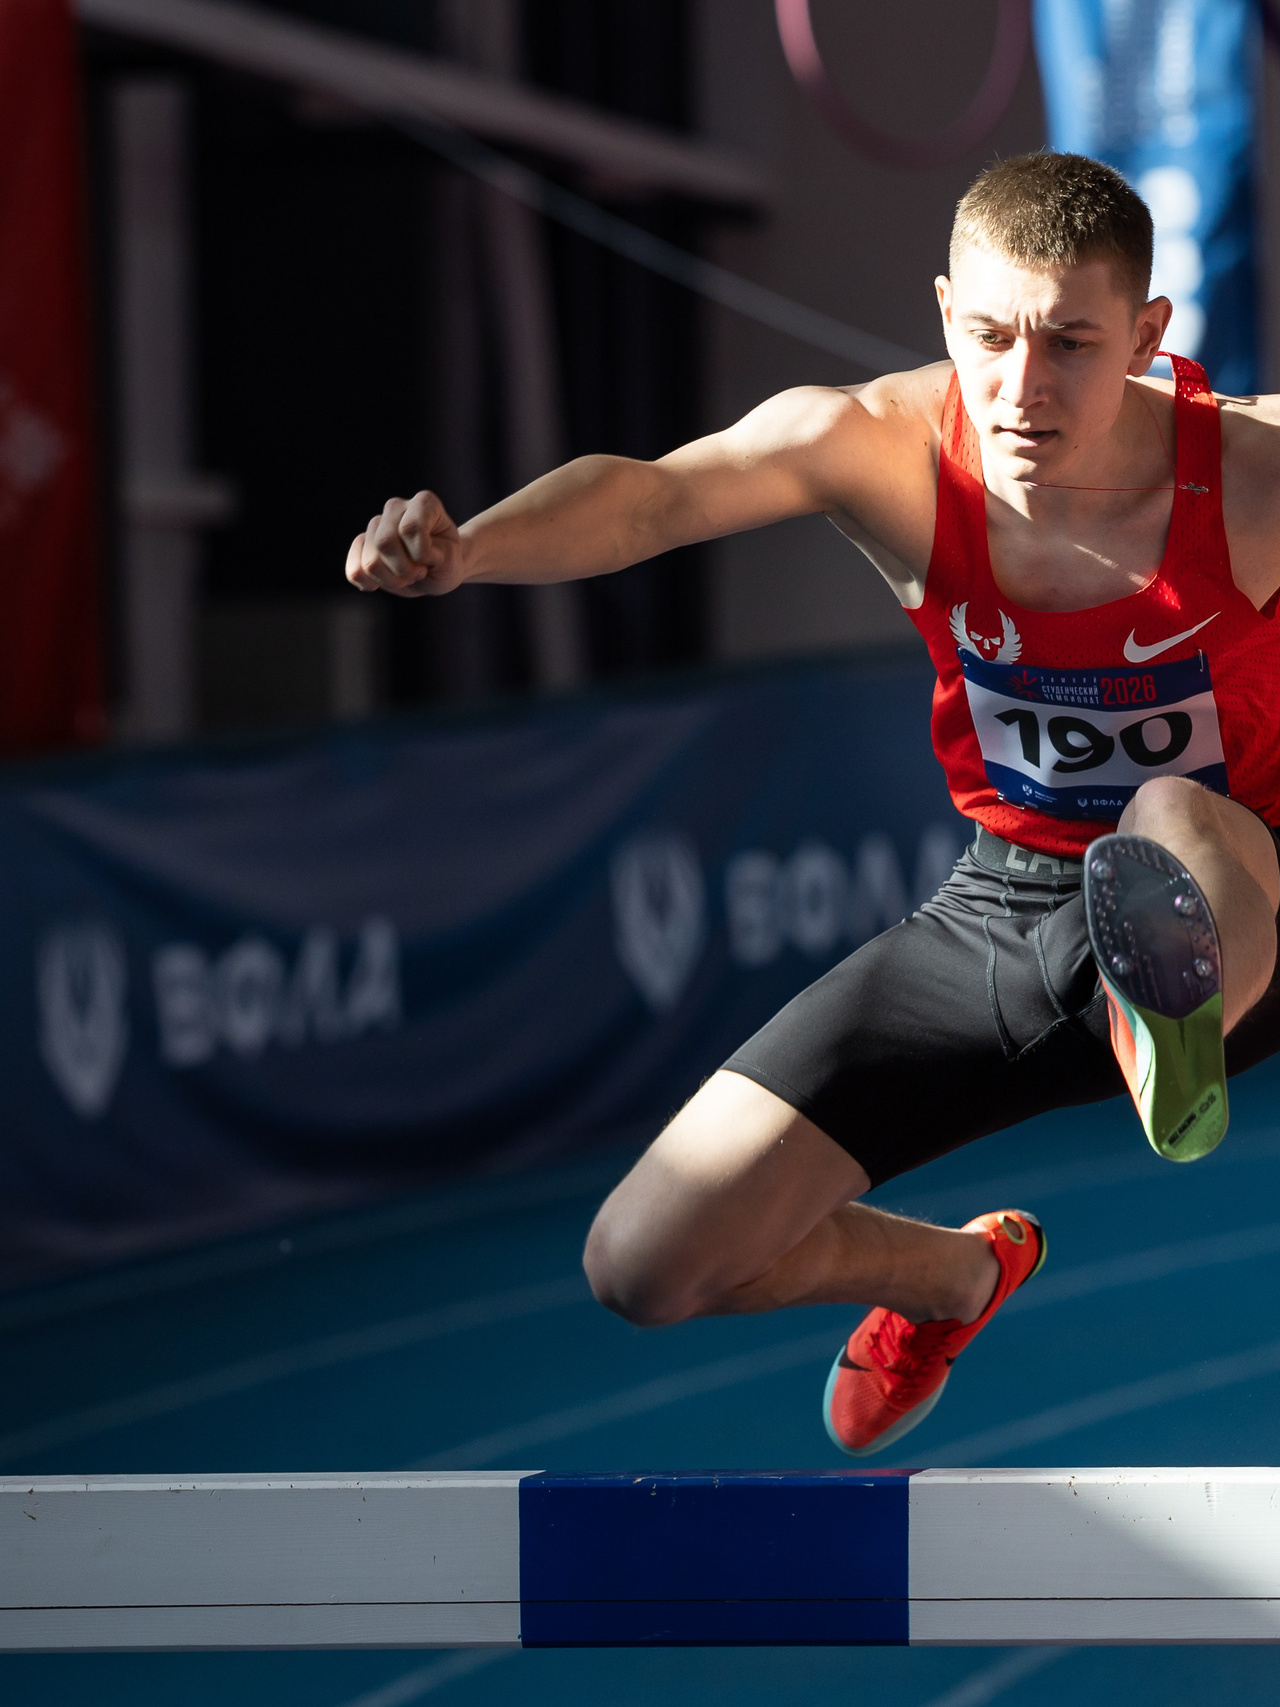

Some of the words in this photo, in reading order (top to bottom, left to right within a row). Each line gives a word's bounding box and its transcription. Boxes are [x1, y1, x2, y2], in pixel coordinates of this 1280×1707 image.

[1041, 685, 1099, 696] СТУДЕНЧЕСКИЙ
[1101, 674, 1157, 705] 2026
[1043, 694, 1100, 704] ЧЕМПИОНАТ
[993, 708, 1193, 773] 190
[1092, 798, 1124, 806] ВФЛА
